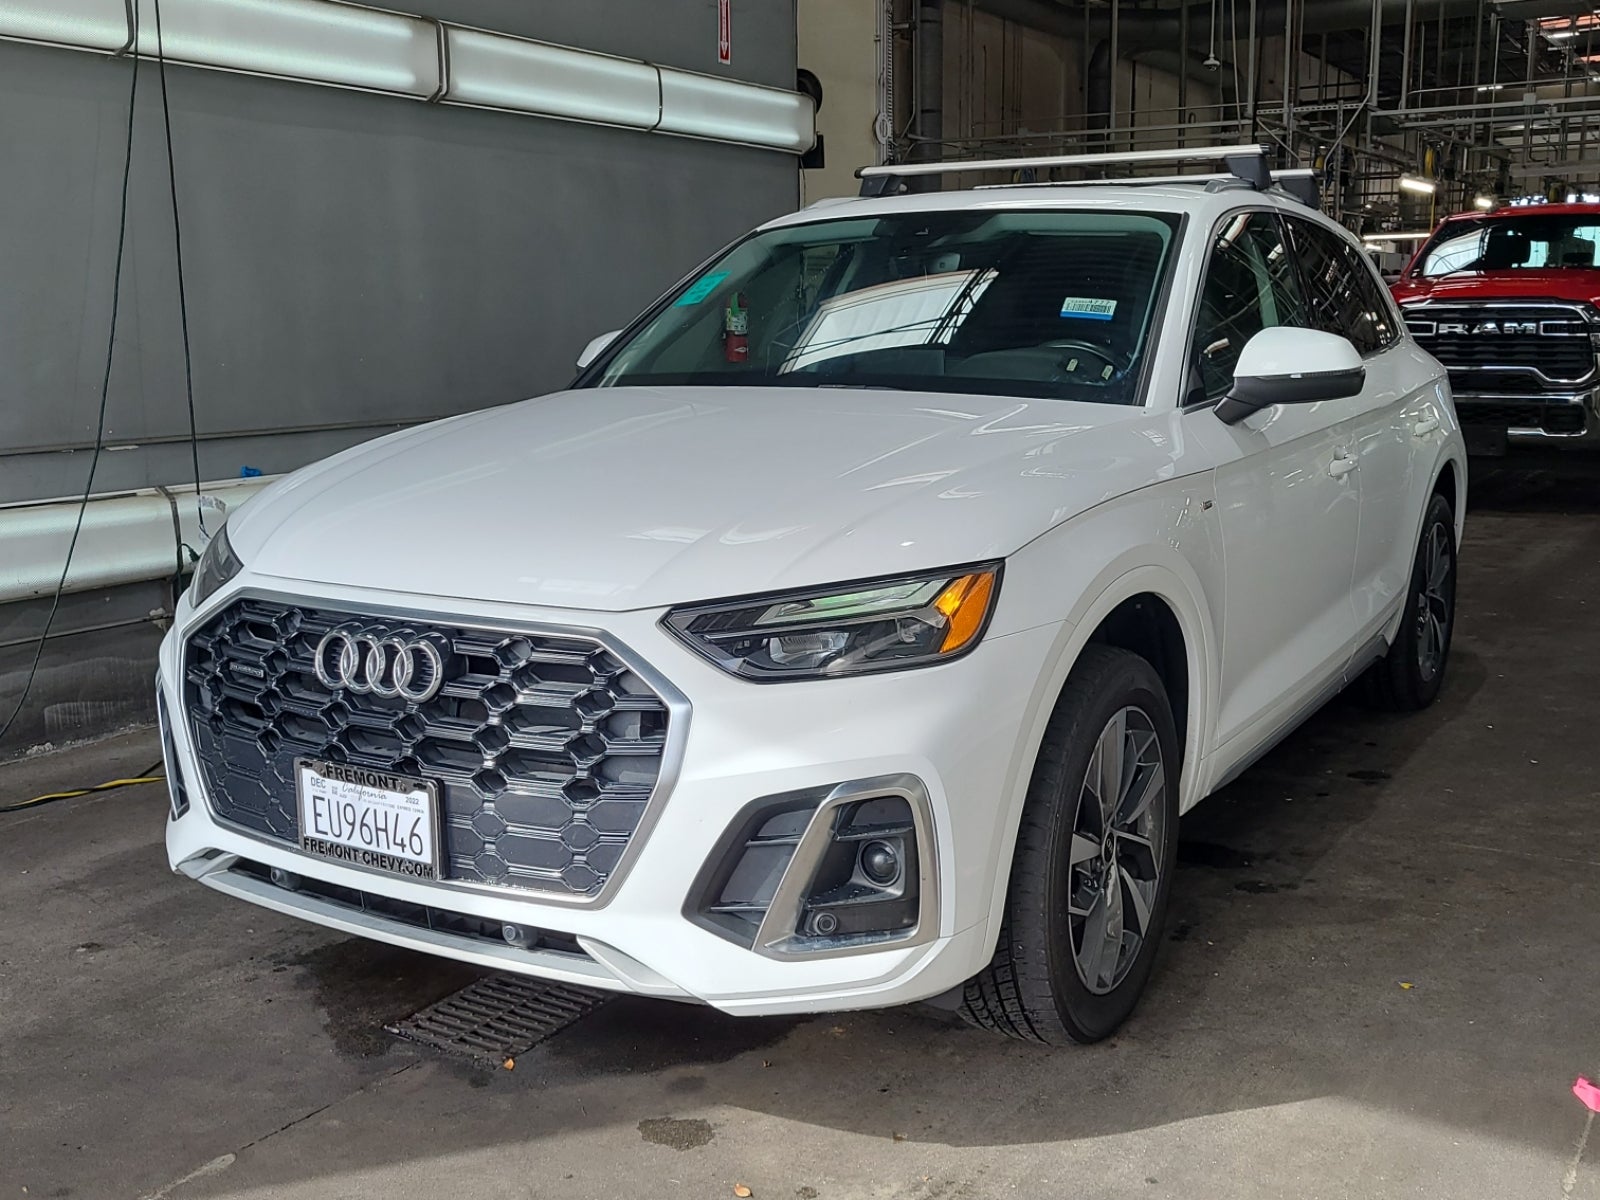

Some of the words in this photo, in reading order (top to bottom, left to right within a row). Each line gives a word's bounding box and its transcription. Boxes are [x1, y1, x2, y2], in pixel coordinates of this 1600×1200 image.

[1438, 322, 1537, 335] RAM
[311, 776, 326, 789] DEC
[325, 764, 400, 789] FREMONT
[342, 781, 388, 801] California
[312, 795, 423, 856] EU96H46
[303, 838, 361, 861] FREMONT
[362, 851, 434, 878] CHEVY.COM
